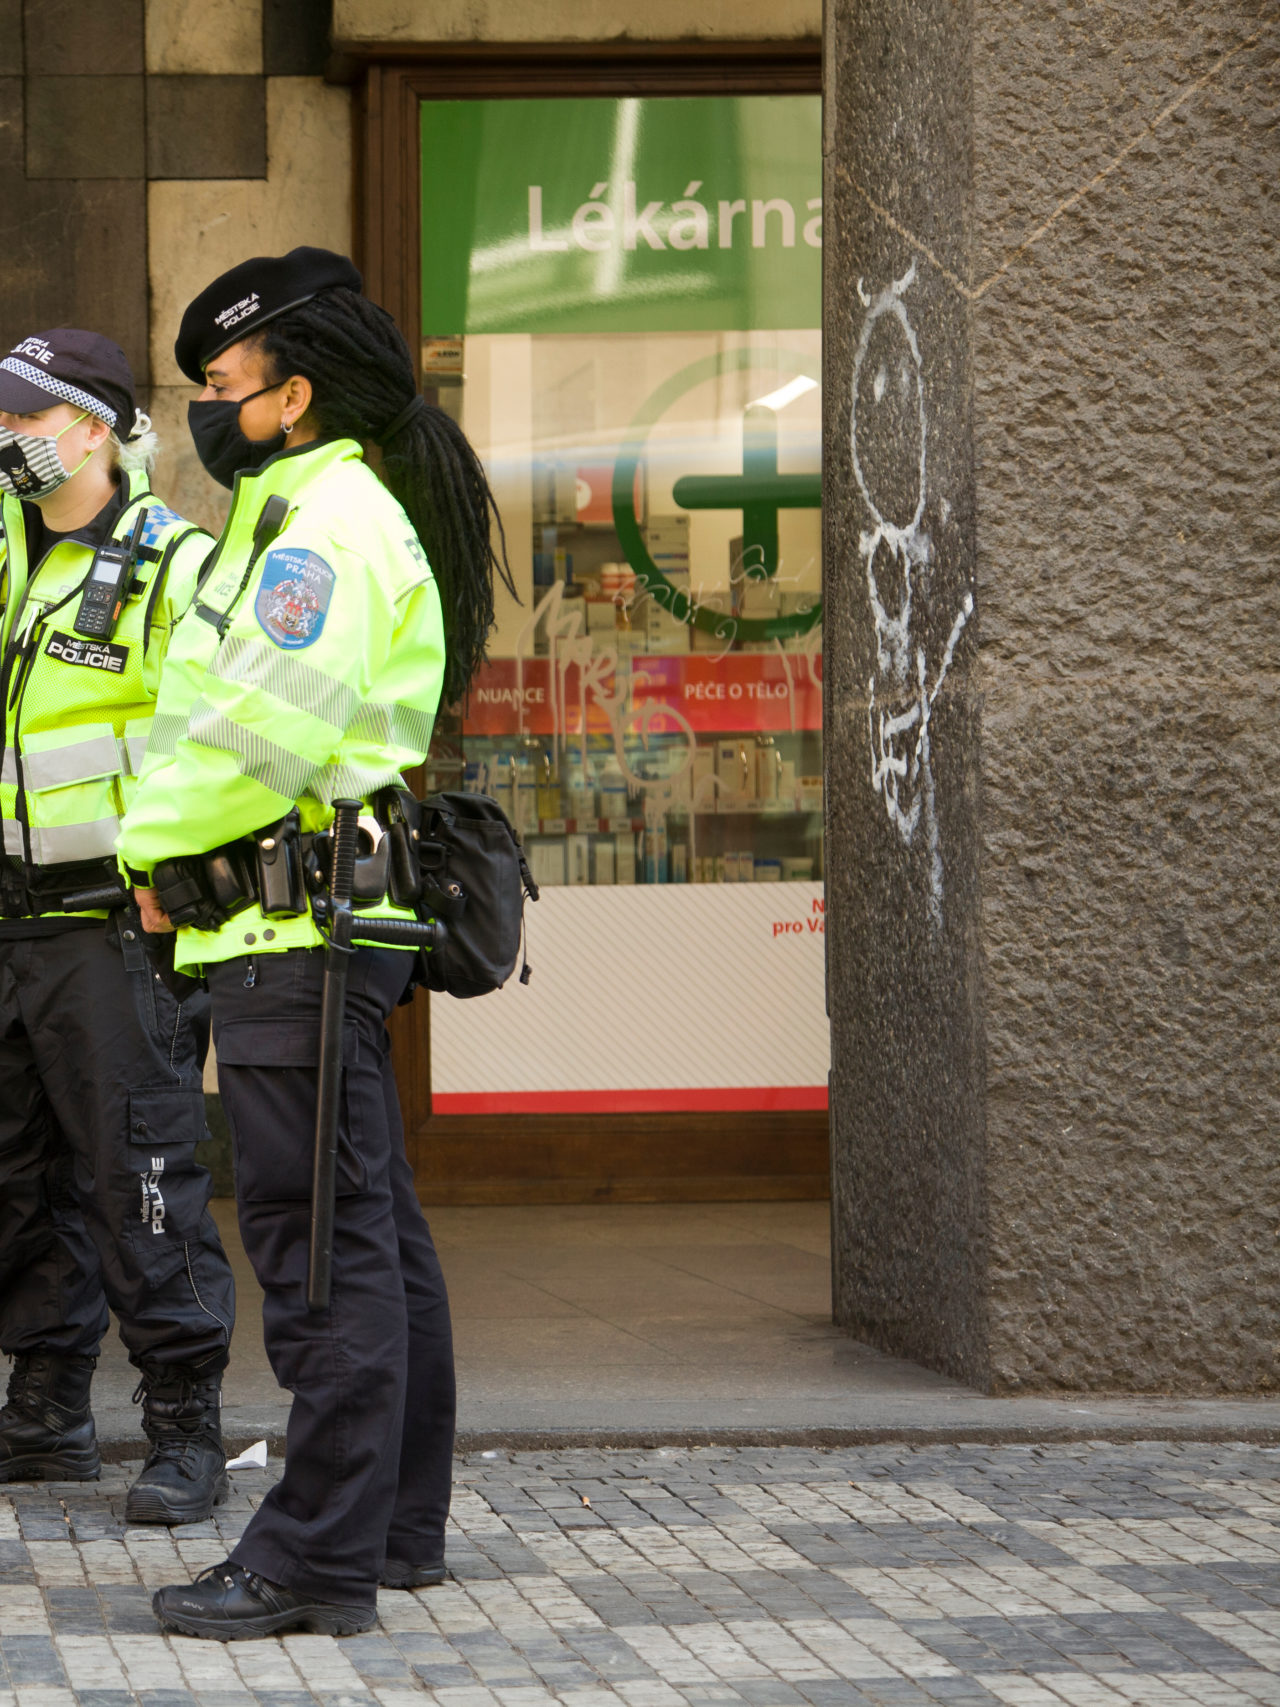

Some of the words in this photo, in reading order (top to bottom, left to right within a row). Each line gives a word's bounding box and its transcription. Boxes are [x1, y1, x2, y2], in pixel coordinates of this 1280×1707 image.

[222, 302, 261, 330] POLICIE
[285, 562, 322, 585] PRAHA
[47, 641, 123, 671] POLICIE
[66, 638, 111, 655] MĚSTSKÁ
[477, 687, 545, 703] NUANCE
[729, 683, 742, 699] O
[772, 921, 803, 939] pro
[148, 1157, 166, 1234] POLICIE
